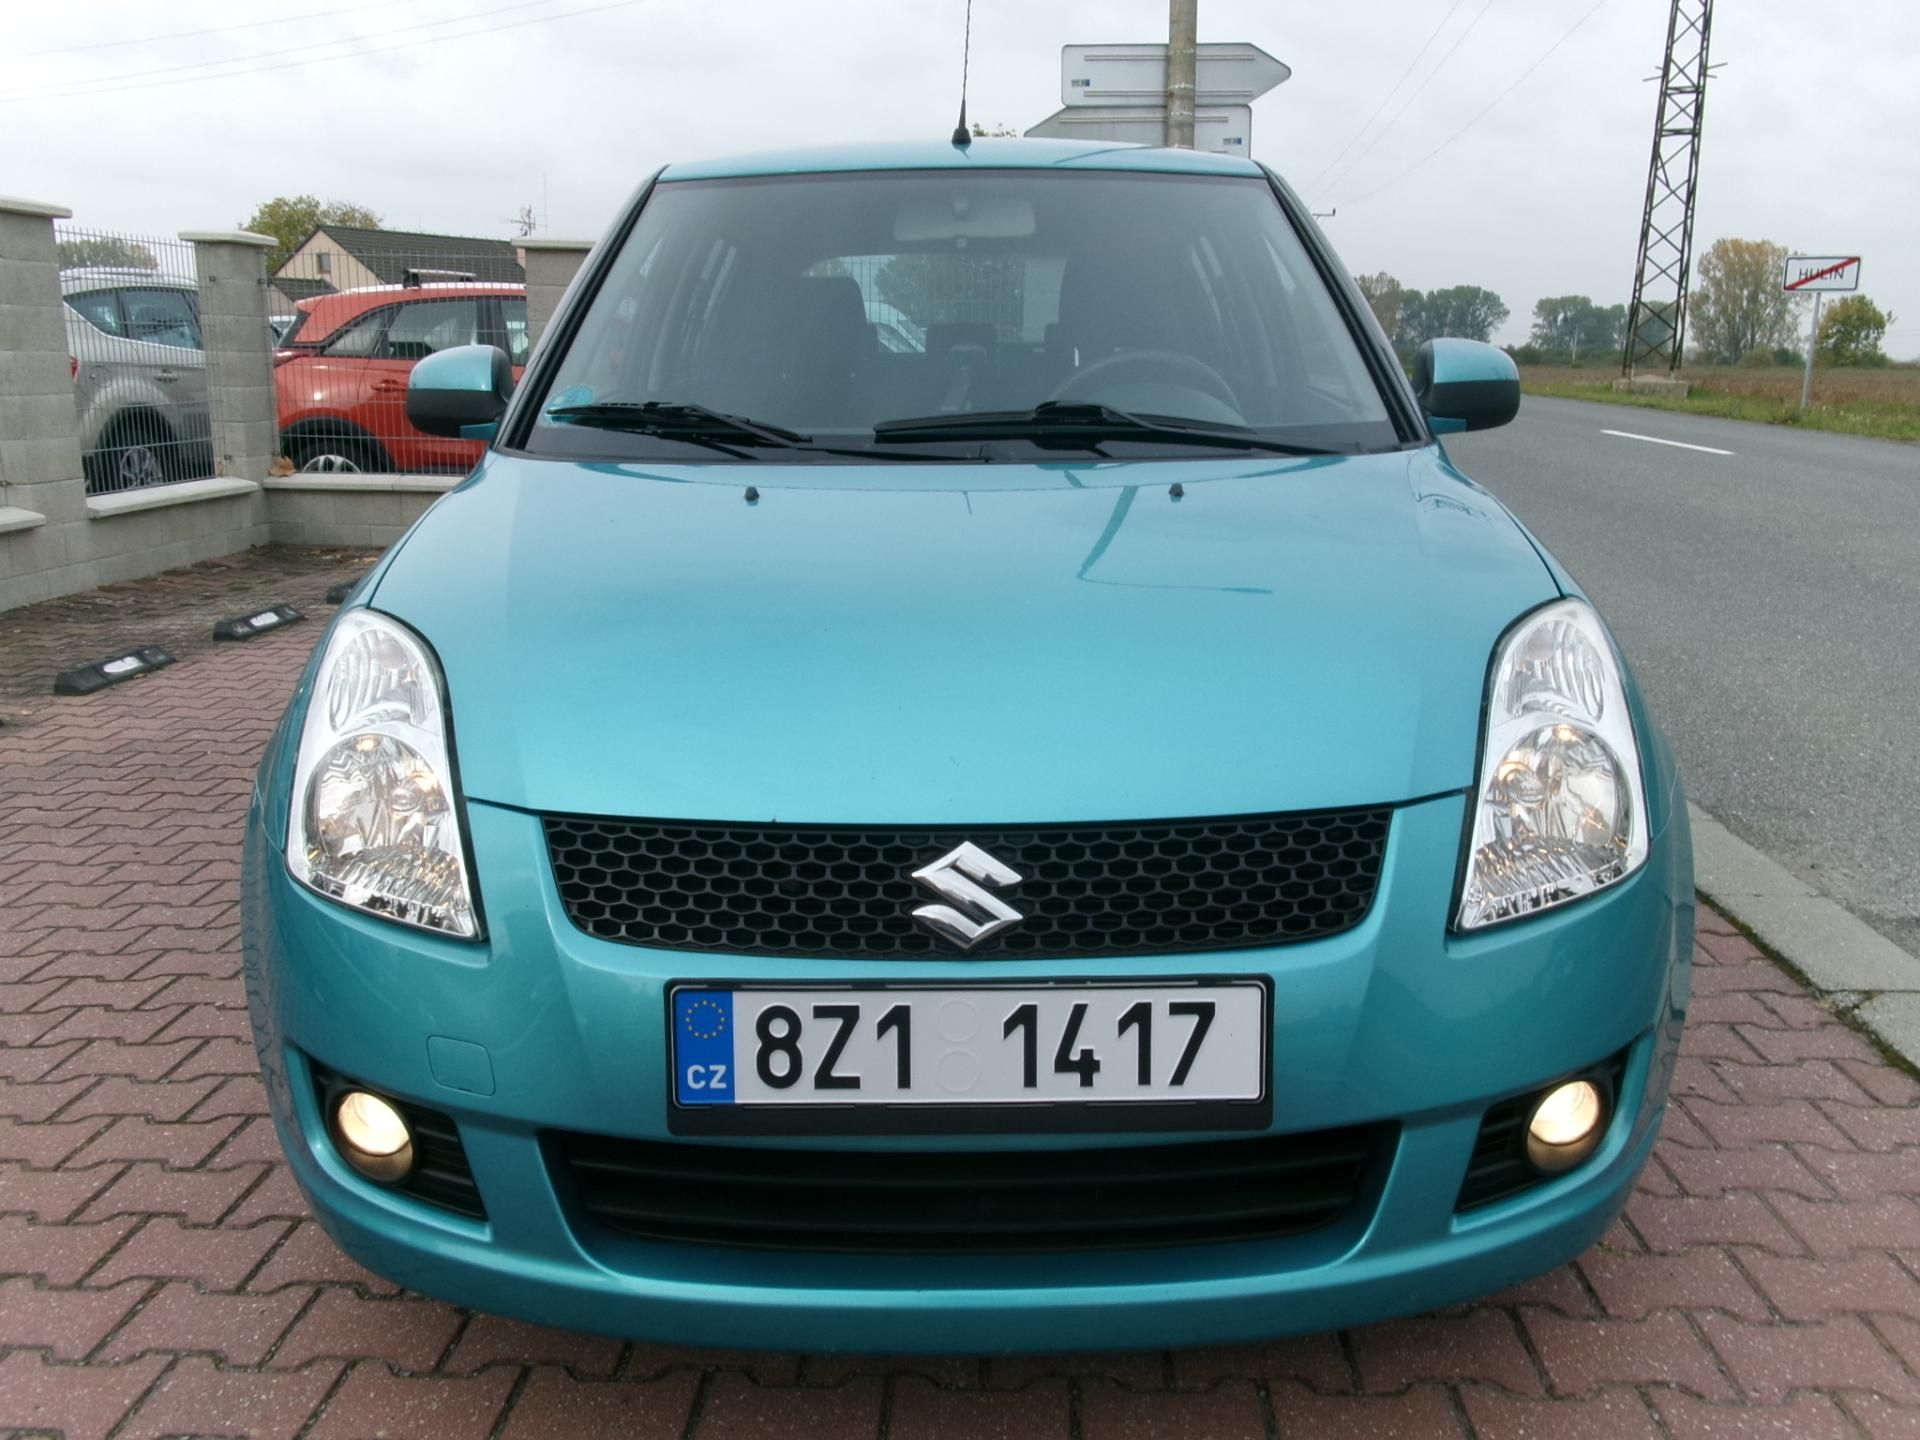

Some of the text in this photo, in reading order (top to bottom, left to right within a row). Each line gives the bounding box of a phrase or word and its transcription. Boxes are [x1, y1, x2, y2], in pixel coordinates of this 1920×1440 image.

[755, 1001, 1216, 1090] 8Z1 1417
[687, 1065, 727, 1089] CZ
